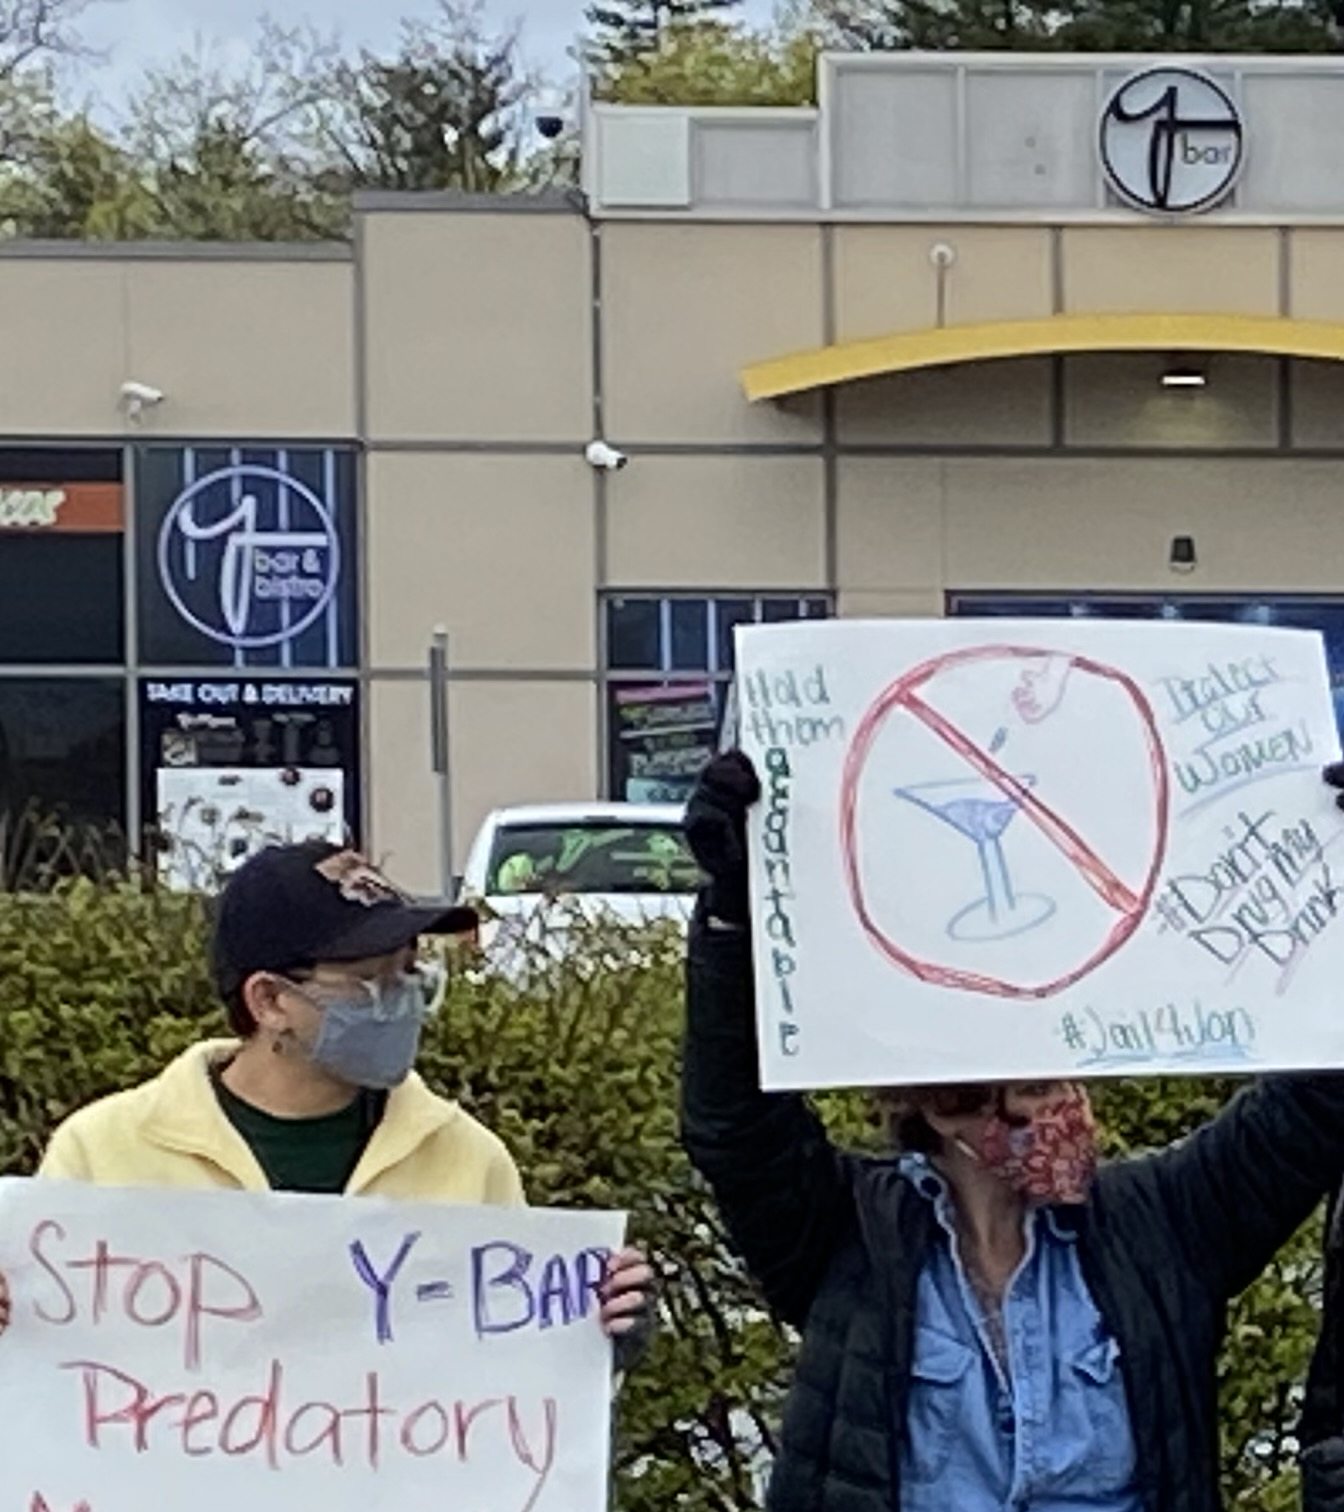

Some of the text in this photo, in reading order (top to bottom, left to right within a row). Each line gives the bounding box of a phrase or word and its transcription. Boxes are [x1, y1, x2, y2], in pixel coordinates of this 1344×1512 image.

[1180, 132, 1232, 165] bar
[254, 549, 298, 575] bar
[302, 549, 321, 574] &
[254, 576, 325, 599] bistro
[147, 684, 354, 705] TAKE OUT & DELIVERY
[743, 664, 831, 708] Hold
[29, 1220, 610, 1372] Stop Y-BAR
